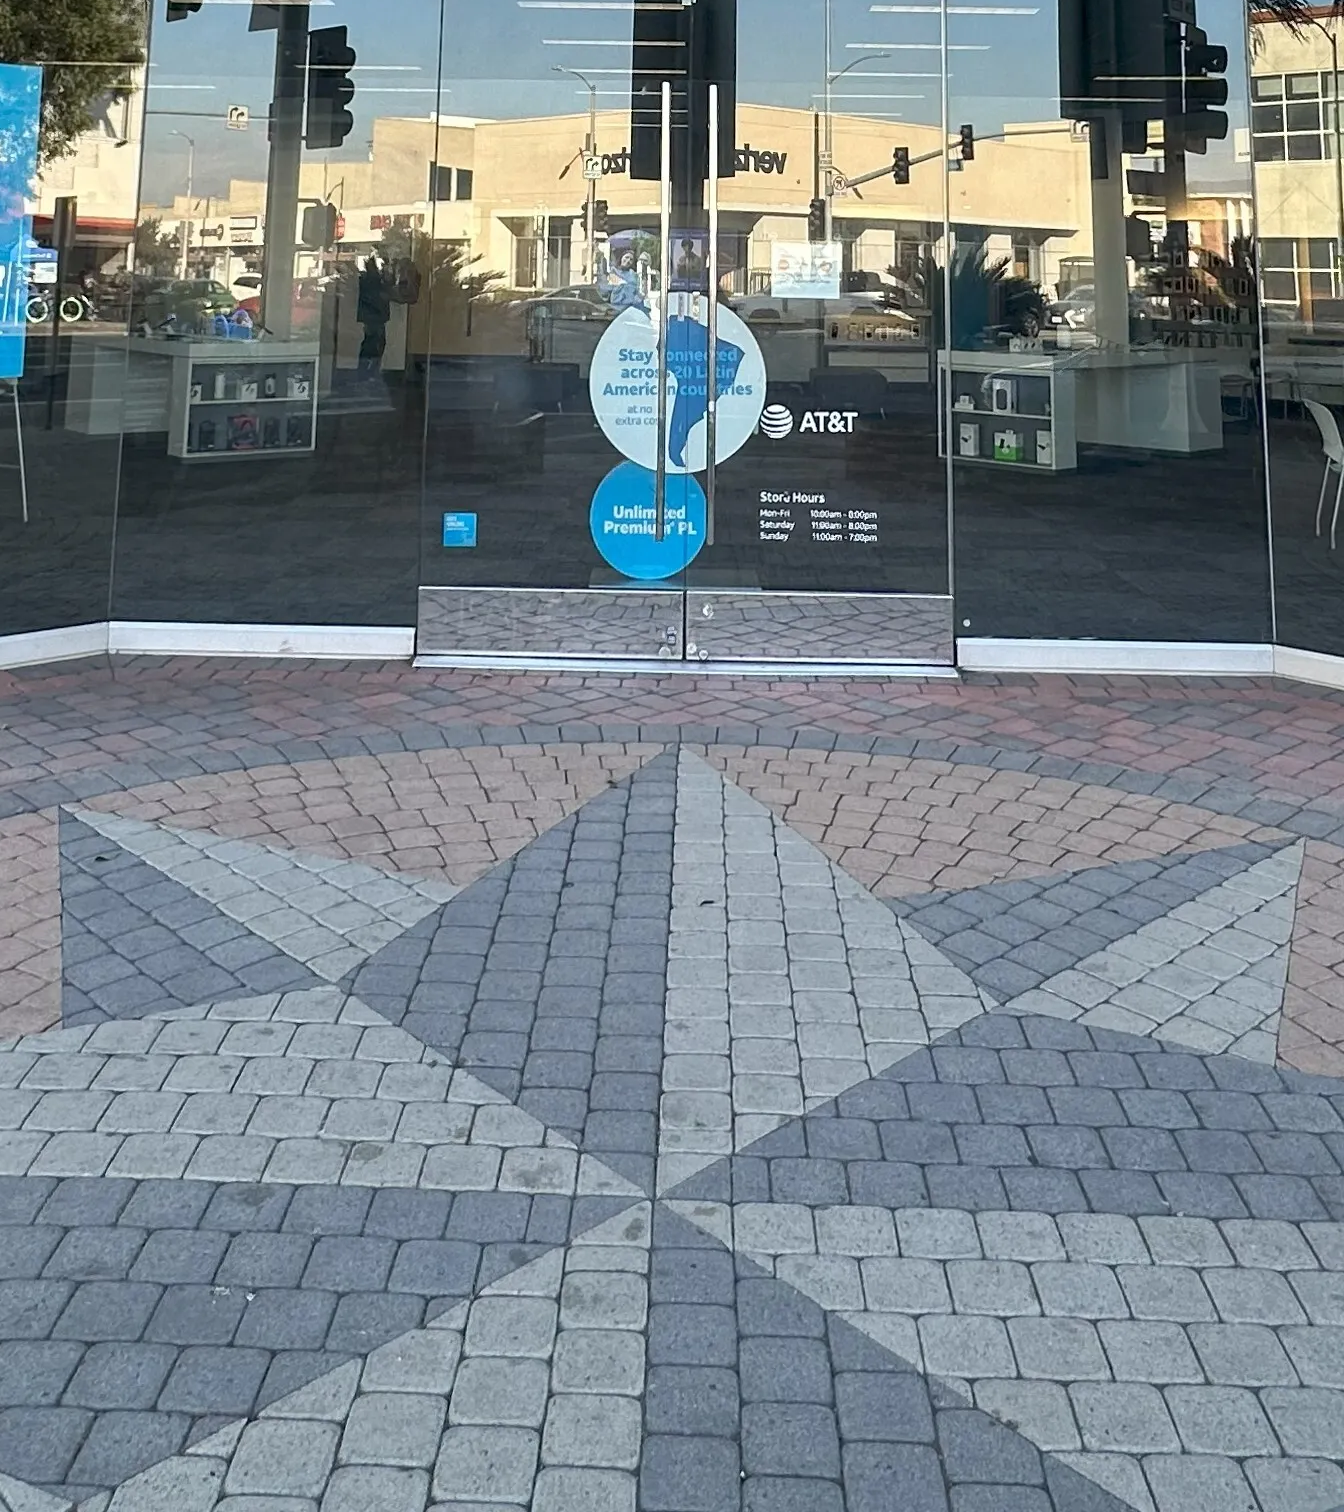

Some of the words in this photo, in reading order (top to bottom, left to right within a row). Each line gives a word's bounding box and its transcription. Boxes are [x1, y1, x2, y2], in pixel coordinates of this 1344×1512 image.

[619, 348, 653, 365] Stay
[659, 347, 738, 362] onneed
[621, 367, 670, 379] acros
[675, 365, 692, 378] 20
[695, 365, 735, 379] Ltin
[603, 382, 675, 396] Americn
[679, 382, 754, 396] coutries
[627, 404, 638, 414] at
[639, 405, 653, 414] no
[615, 416, 642, 426] extra
[799, 411, 858, 433] AT&T
[792, 491, 826, 504] Hours
[613, 505, 686, 519] Unlimted
[759, 509, 791, 518] Mon-Fri
[677, 522, 698, 535] PL
[759, 519, 796, 531] Saturday
[759, 531, 790, 543] Sunday
